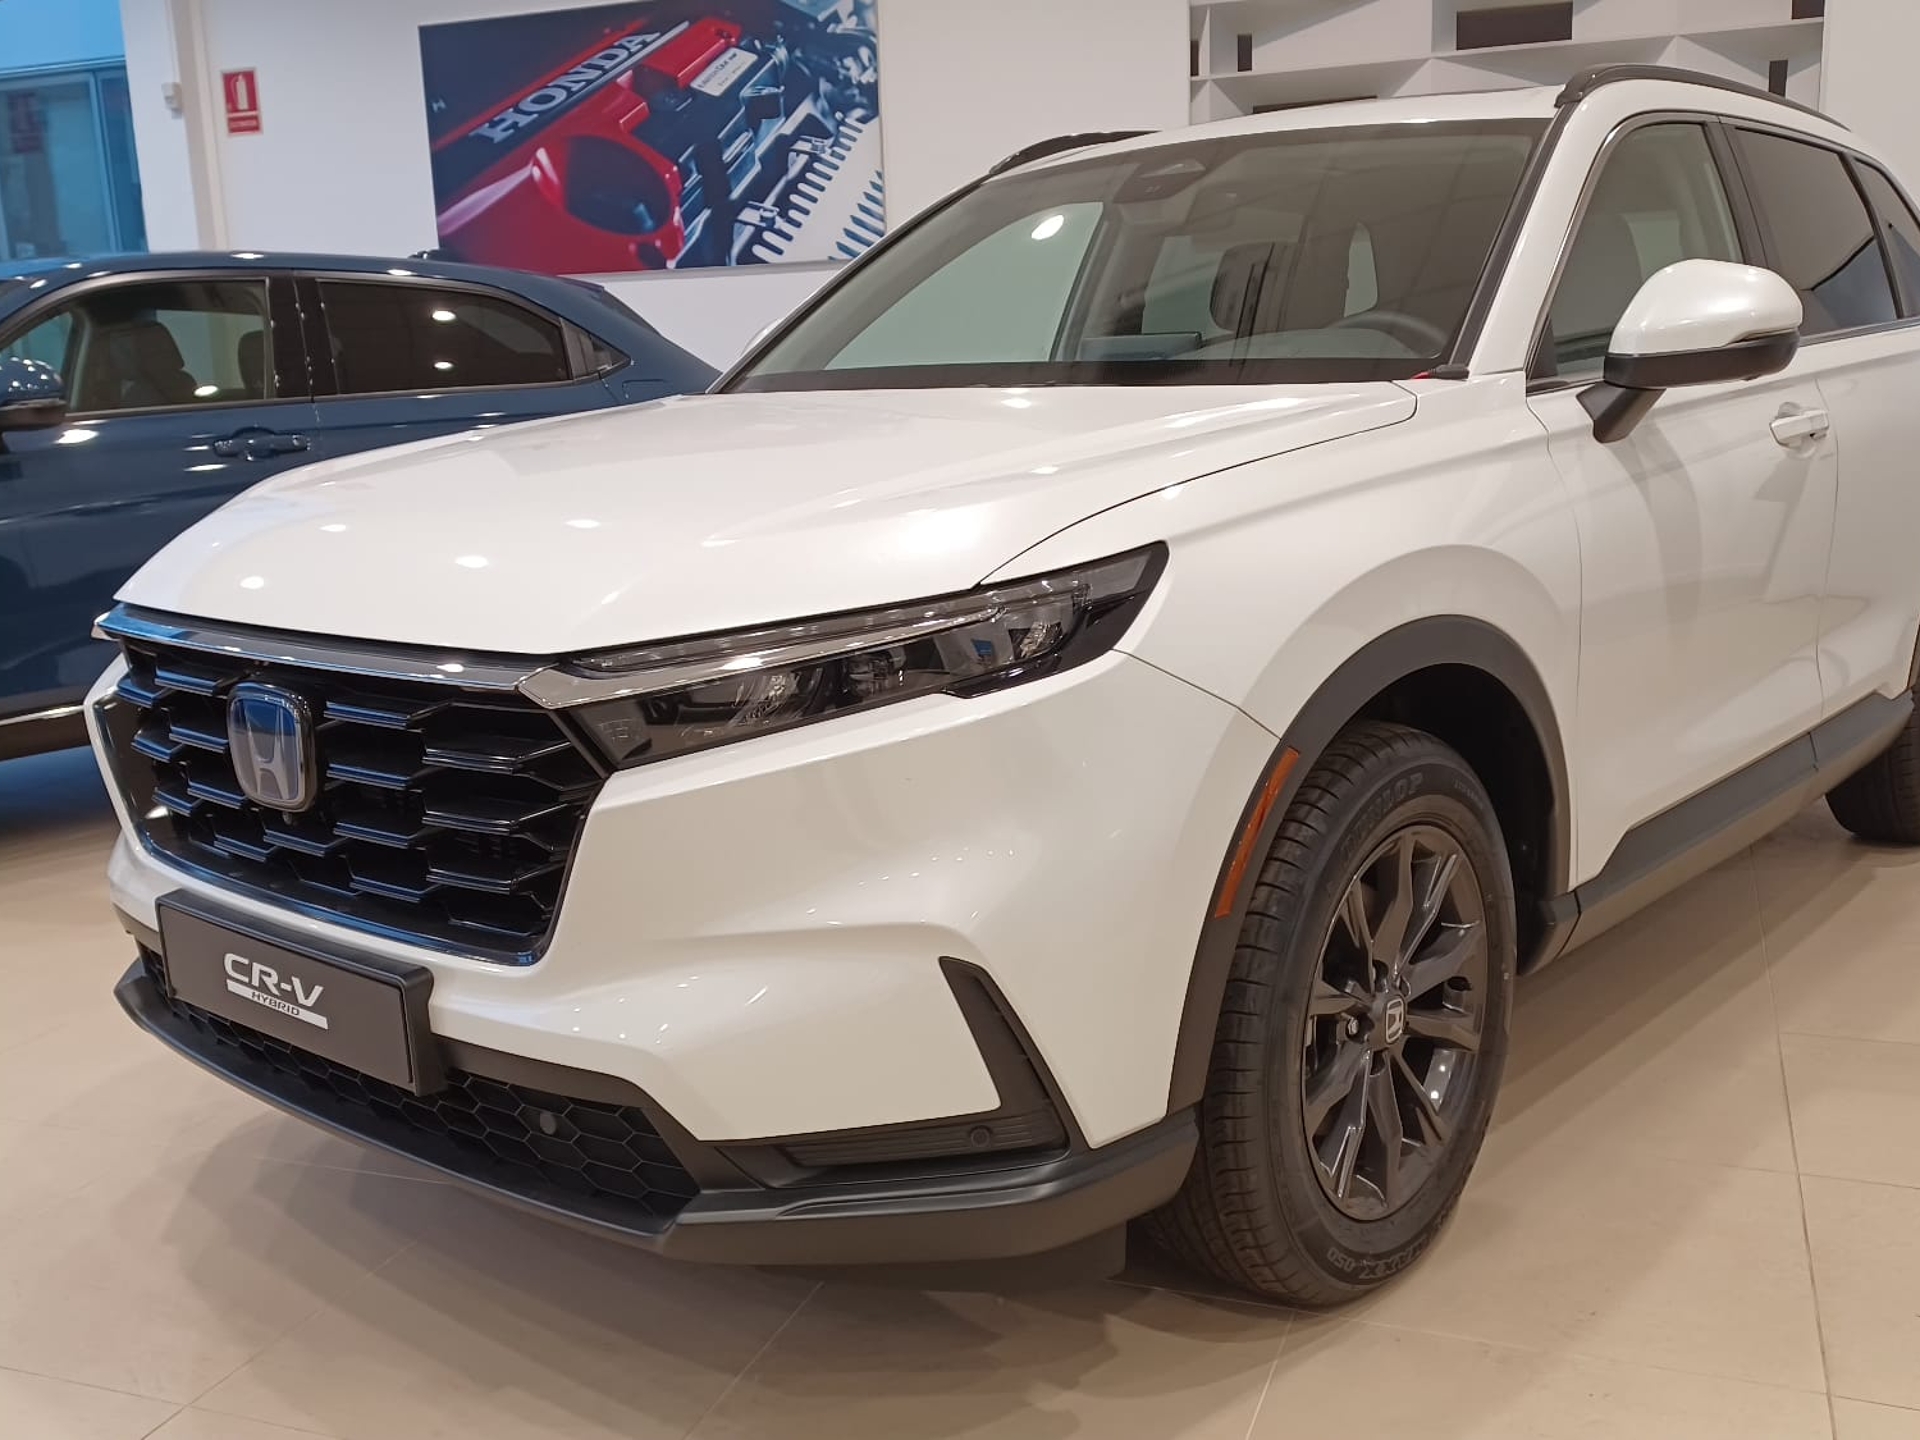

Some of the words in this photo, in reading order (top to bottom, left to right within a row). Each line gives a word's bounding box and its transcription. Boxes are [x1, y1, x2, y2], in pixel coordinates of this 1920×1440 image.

[469, 32, 661, 143] HONDA
[224, 953, 324, 1007] CR-V
[251, 991, 301, 1016] HYBRID
